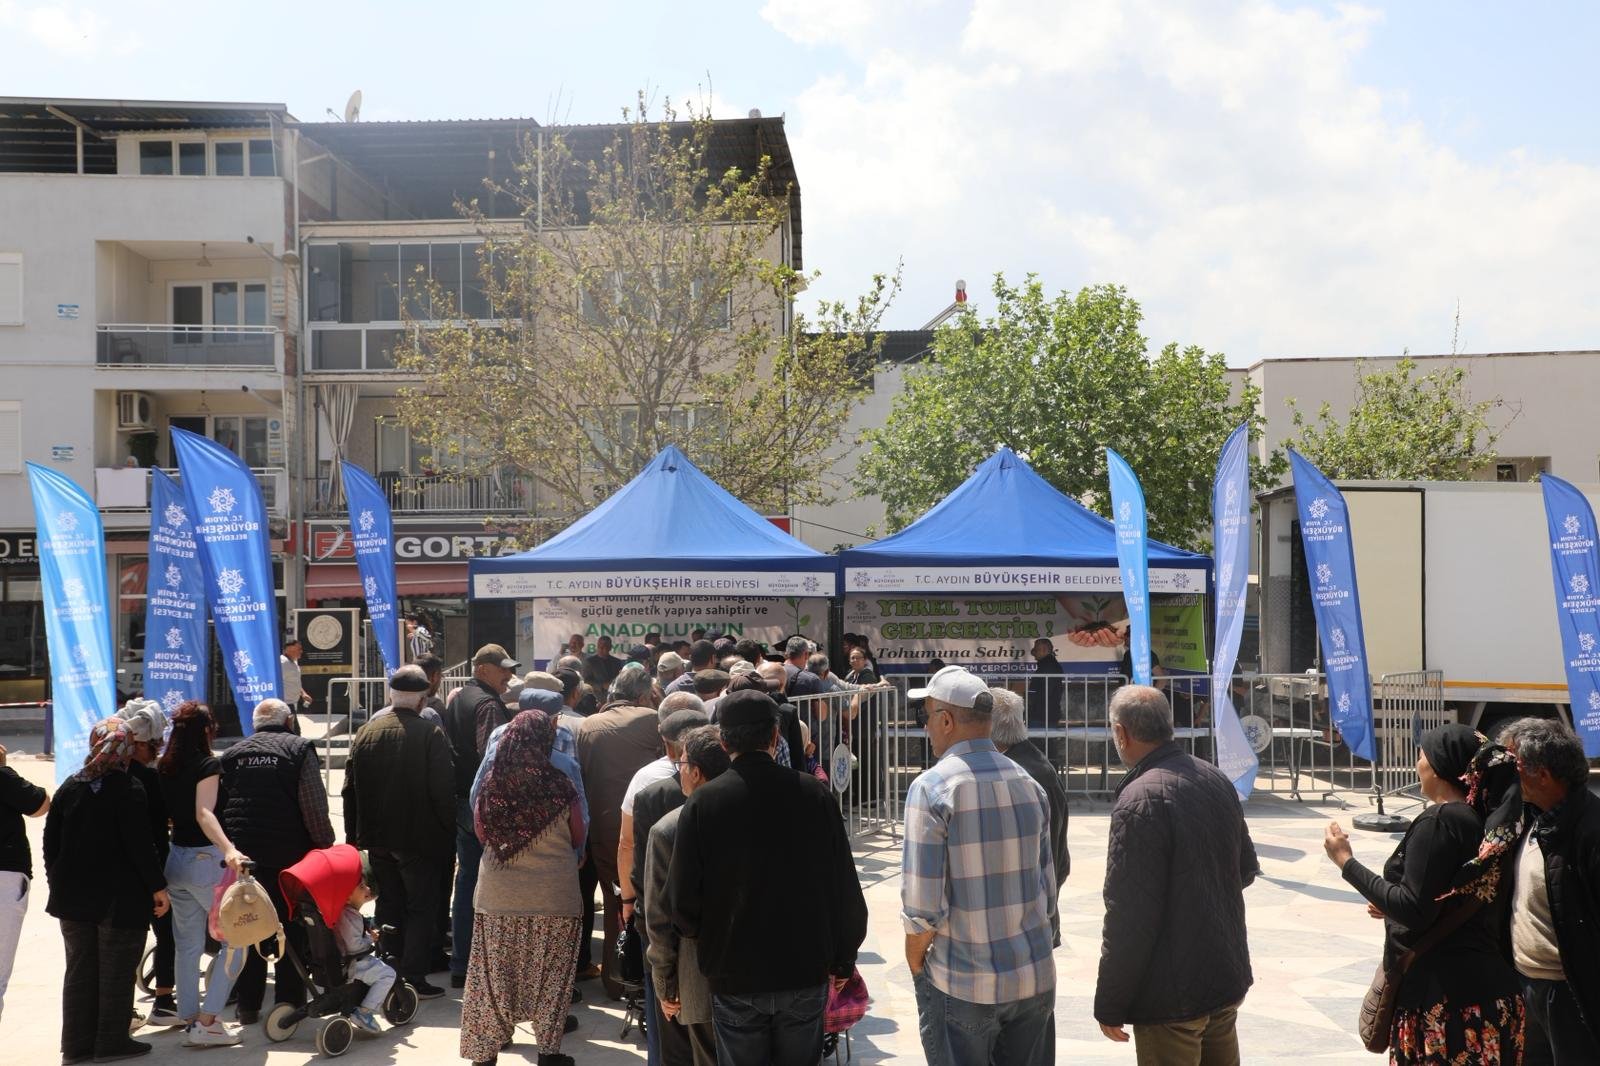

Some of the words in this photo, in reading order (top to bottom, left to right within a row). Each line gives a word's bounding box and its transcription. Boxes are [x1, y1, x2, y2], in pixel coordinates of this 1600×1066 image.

[547, 580, 567, 589] T.C.
[568, 580, 602, 589] AYDIN
[606, 576, 692, 591] BÜYÜKŞEHİR
[696, 578, 760, 589] BELEDİYESİ
[915, 575, 934, 584] T.C.
[936, 575, 970, 584] AYDIN
[974, 572, 1061, 586] BÜYÜKŞEHİR
[1065, 575, 1122, 585] BELEDİYES
[581, 605, 613, 618] güçlü
[616, 604, 660, 617] genetik
[664, 608, 702, 618] yapıya
[705, 605, 750, 617] sahiptir
[876, 599, 959, 617] YEREL
[964, 599, 1057, 616] TOHUM
[880, 617, 1041, 639] GELECEKTİR
[1045, 620, 1054, 638] !
[876, 646, 971, 660] Tohumuna
[974, 645, 1026, 660] Sahip
[980, 662, 1038, 673] ÇERÇİOĞLU
[248, 756, 279, 765] YAPAR
